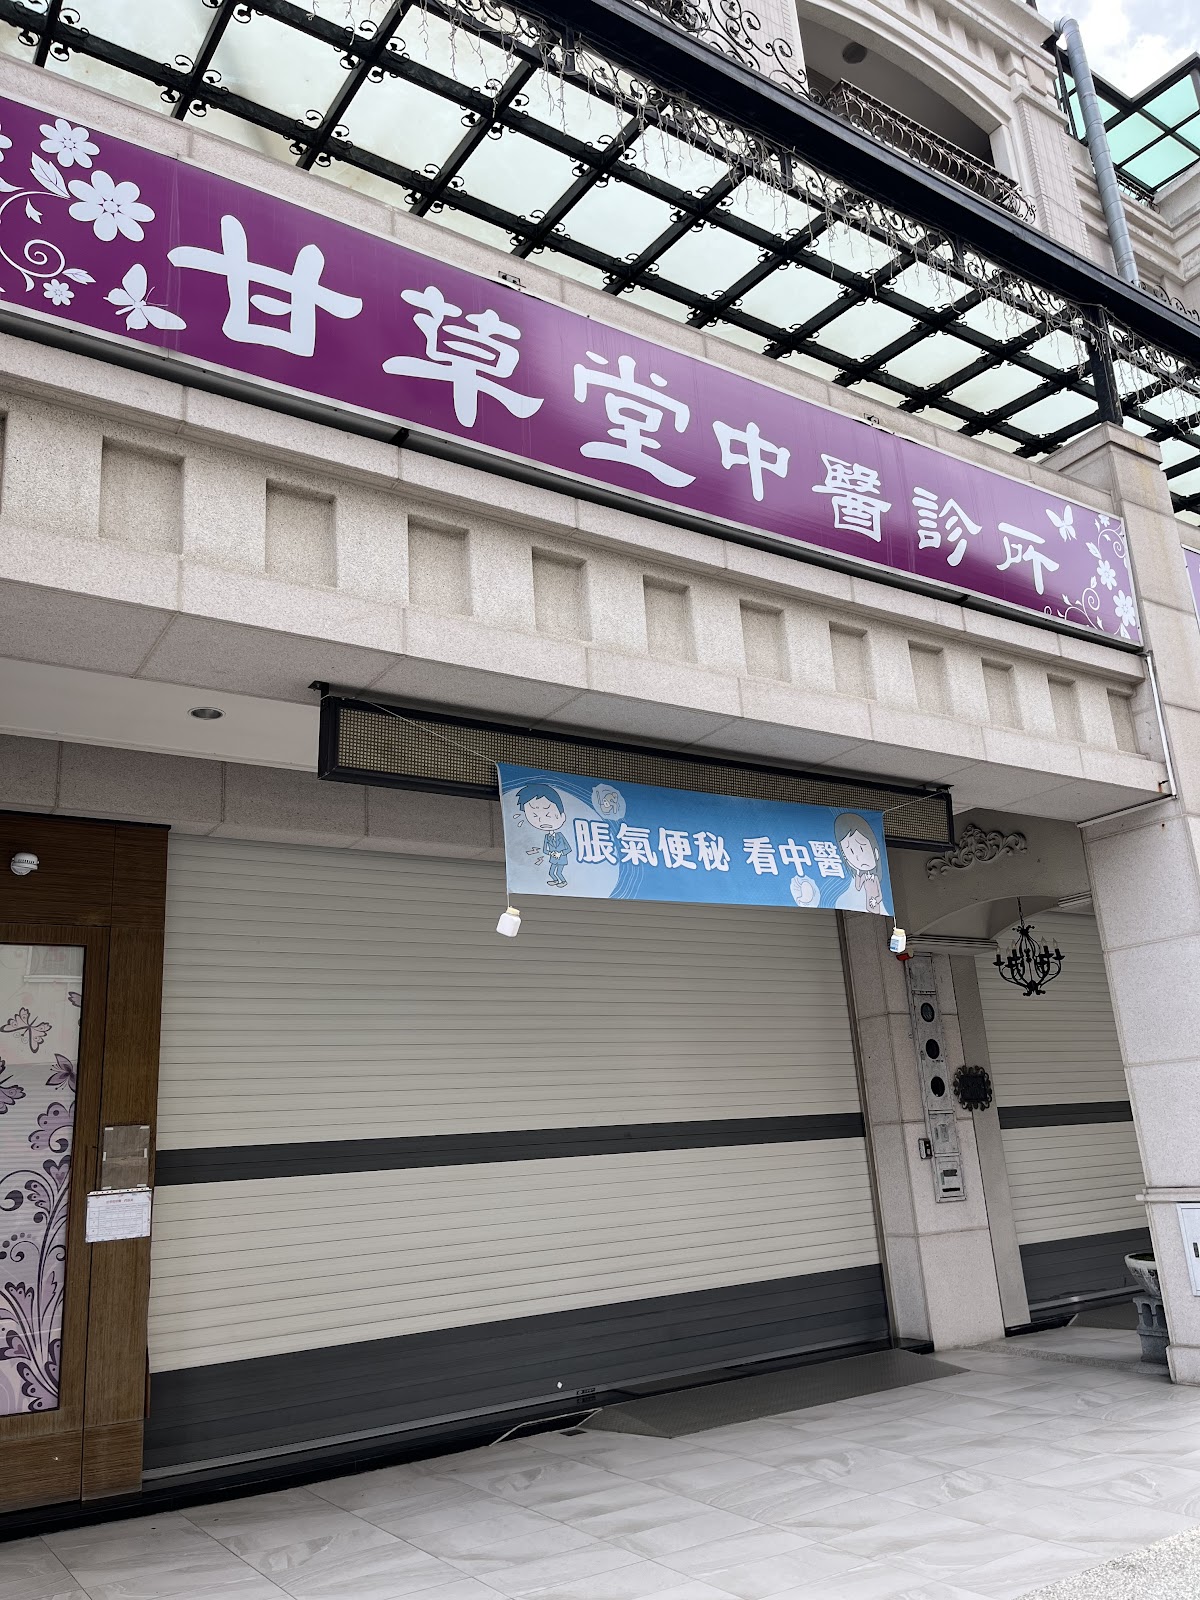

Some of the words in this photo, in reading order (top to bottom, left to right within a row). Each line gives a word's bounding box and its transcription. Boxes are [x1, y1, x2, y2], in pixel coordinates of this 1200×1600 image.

[167, 214, 1059, 595] 甘草堂中醫診所
[574, 819, 731, 872] 脹氣便秘
[742, 836, 845, 879] 看中醫
